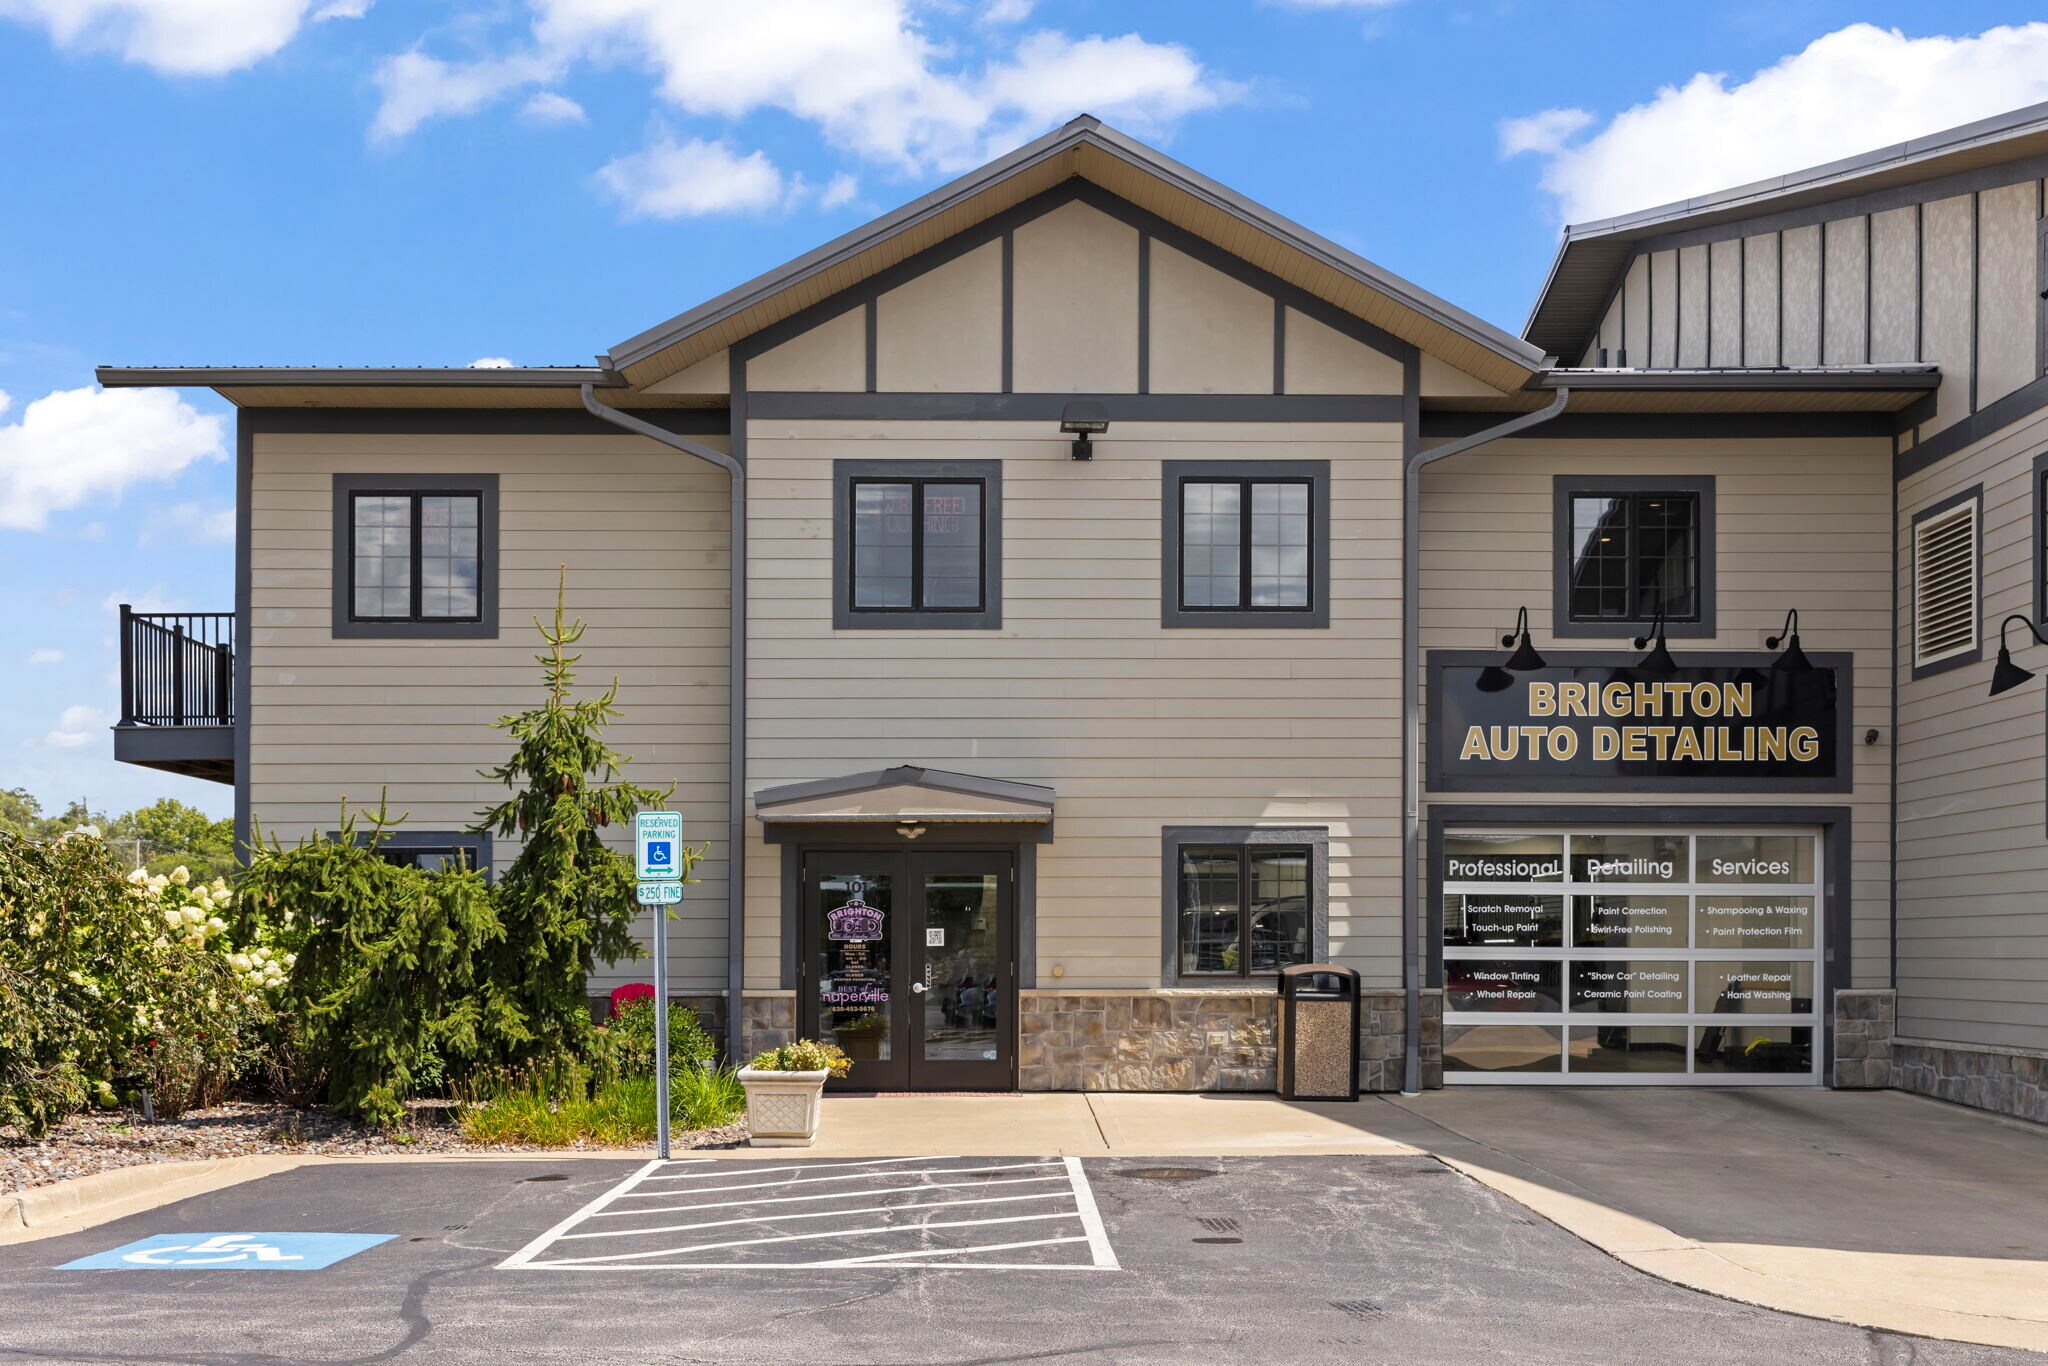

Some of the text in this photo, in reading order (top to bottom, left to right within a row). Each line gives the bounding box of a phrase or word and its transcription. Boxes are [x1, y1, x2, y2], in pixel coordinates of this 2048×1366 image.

[1528, 682, 1752, 717] BRIGHTON
[1459, 726, 1820, 761] AUTO DETAILING
[640, 819, 678, 828] RESERVED
[643, 830, 675, 839] PARKING
[1449, 859, 1558, 876] Professional
[1587, 859, 1673, 879] Detailing
[1712, 859, 1790, 875] Services
[664, 886, 681, 898] FINE
[845, 881, 867, 893] 101
[830, 907, 881, 920] BRIGHTON
[1467, 905, 1543, 914] Scratch Removal
[1598, 907, 1667, 915] Paint Correction
[1707, 906, 1808, 916] Shampooing & Waxing
[1472, 923, 1539, 933] Touch-up Paint
[1593, 925, 1672, 935] Swirl-Free Polishing
[1713, 926, 1803, 936] Paint Protection Film
[1473, 971, 1540, 982] Window Tinting
[1639, 972, 1680, 982] Detailing
[1727, 973, 1792, 983] Leather Repair
[822, 987, 889, 1006] naperville
[1476, 990, 1537, 1000] Wheel Repair
[1583, 990, 1682, 999] Ceramic Paint Coating
[1727, 991, 1791, 1000] Hand Washing
